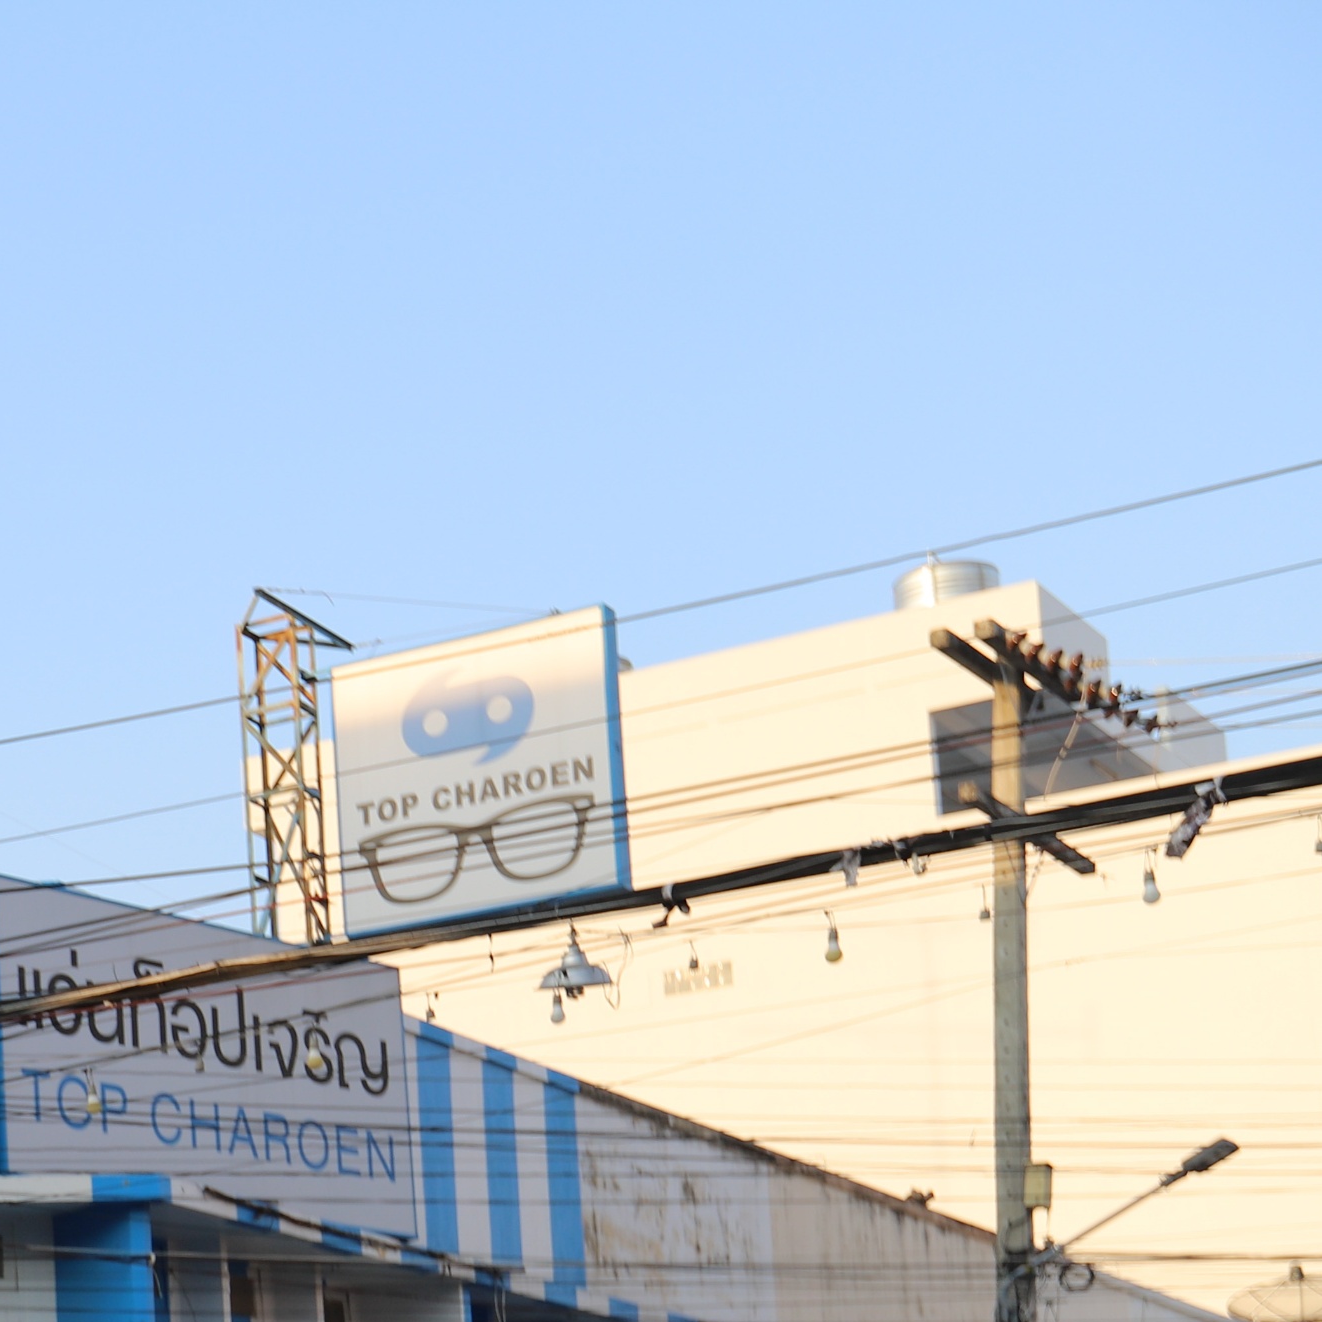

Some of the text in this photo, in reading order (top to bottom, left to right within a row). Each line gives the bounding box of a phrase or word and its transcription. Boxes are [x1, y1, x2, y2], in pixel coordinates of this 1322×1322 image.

[356, 755, 596, 827] TOP CHAROEN
[21, 1068, 396, 1183] TOP CHAROEN
